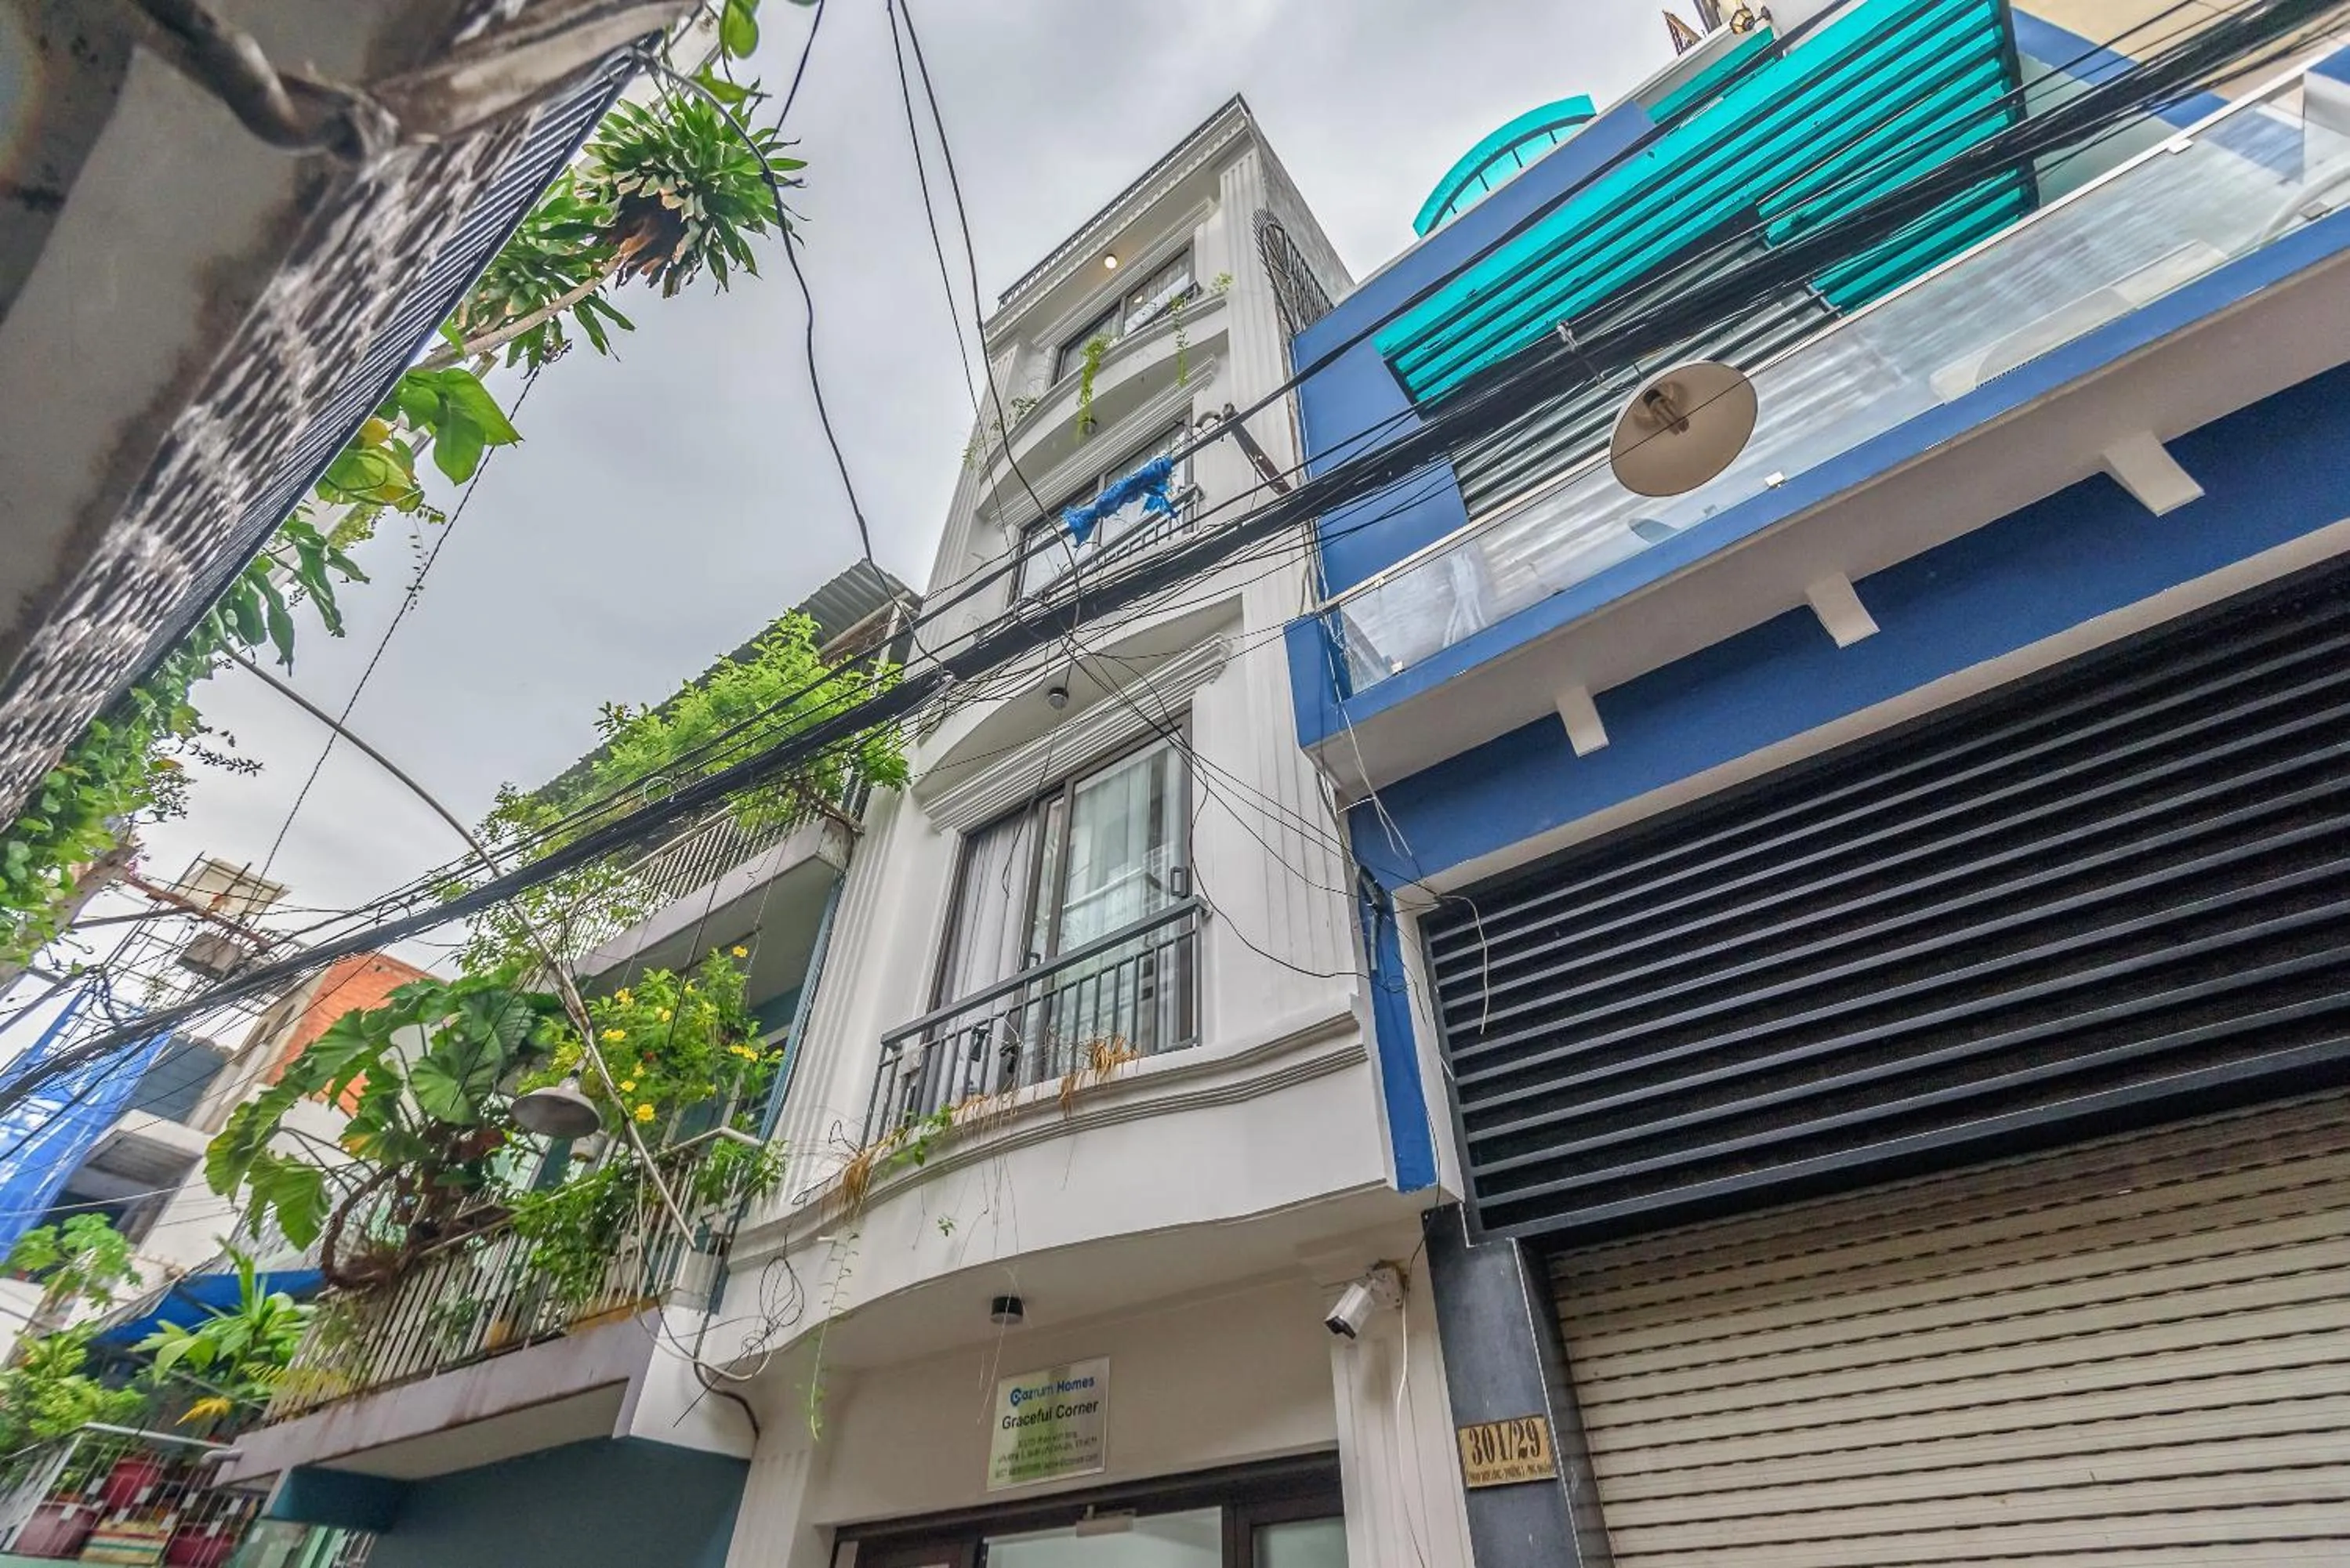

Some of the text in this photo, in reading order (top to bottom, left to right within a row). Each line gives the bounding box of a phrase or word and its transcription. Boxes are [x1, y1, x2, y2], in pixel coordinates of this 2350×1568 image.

[1057, 1377, 1094, 1393] Homes
[1002, 1401, 1099, 1429] Graceful Corner
[1469, 1418, 1540, 1465] 301/29
